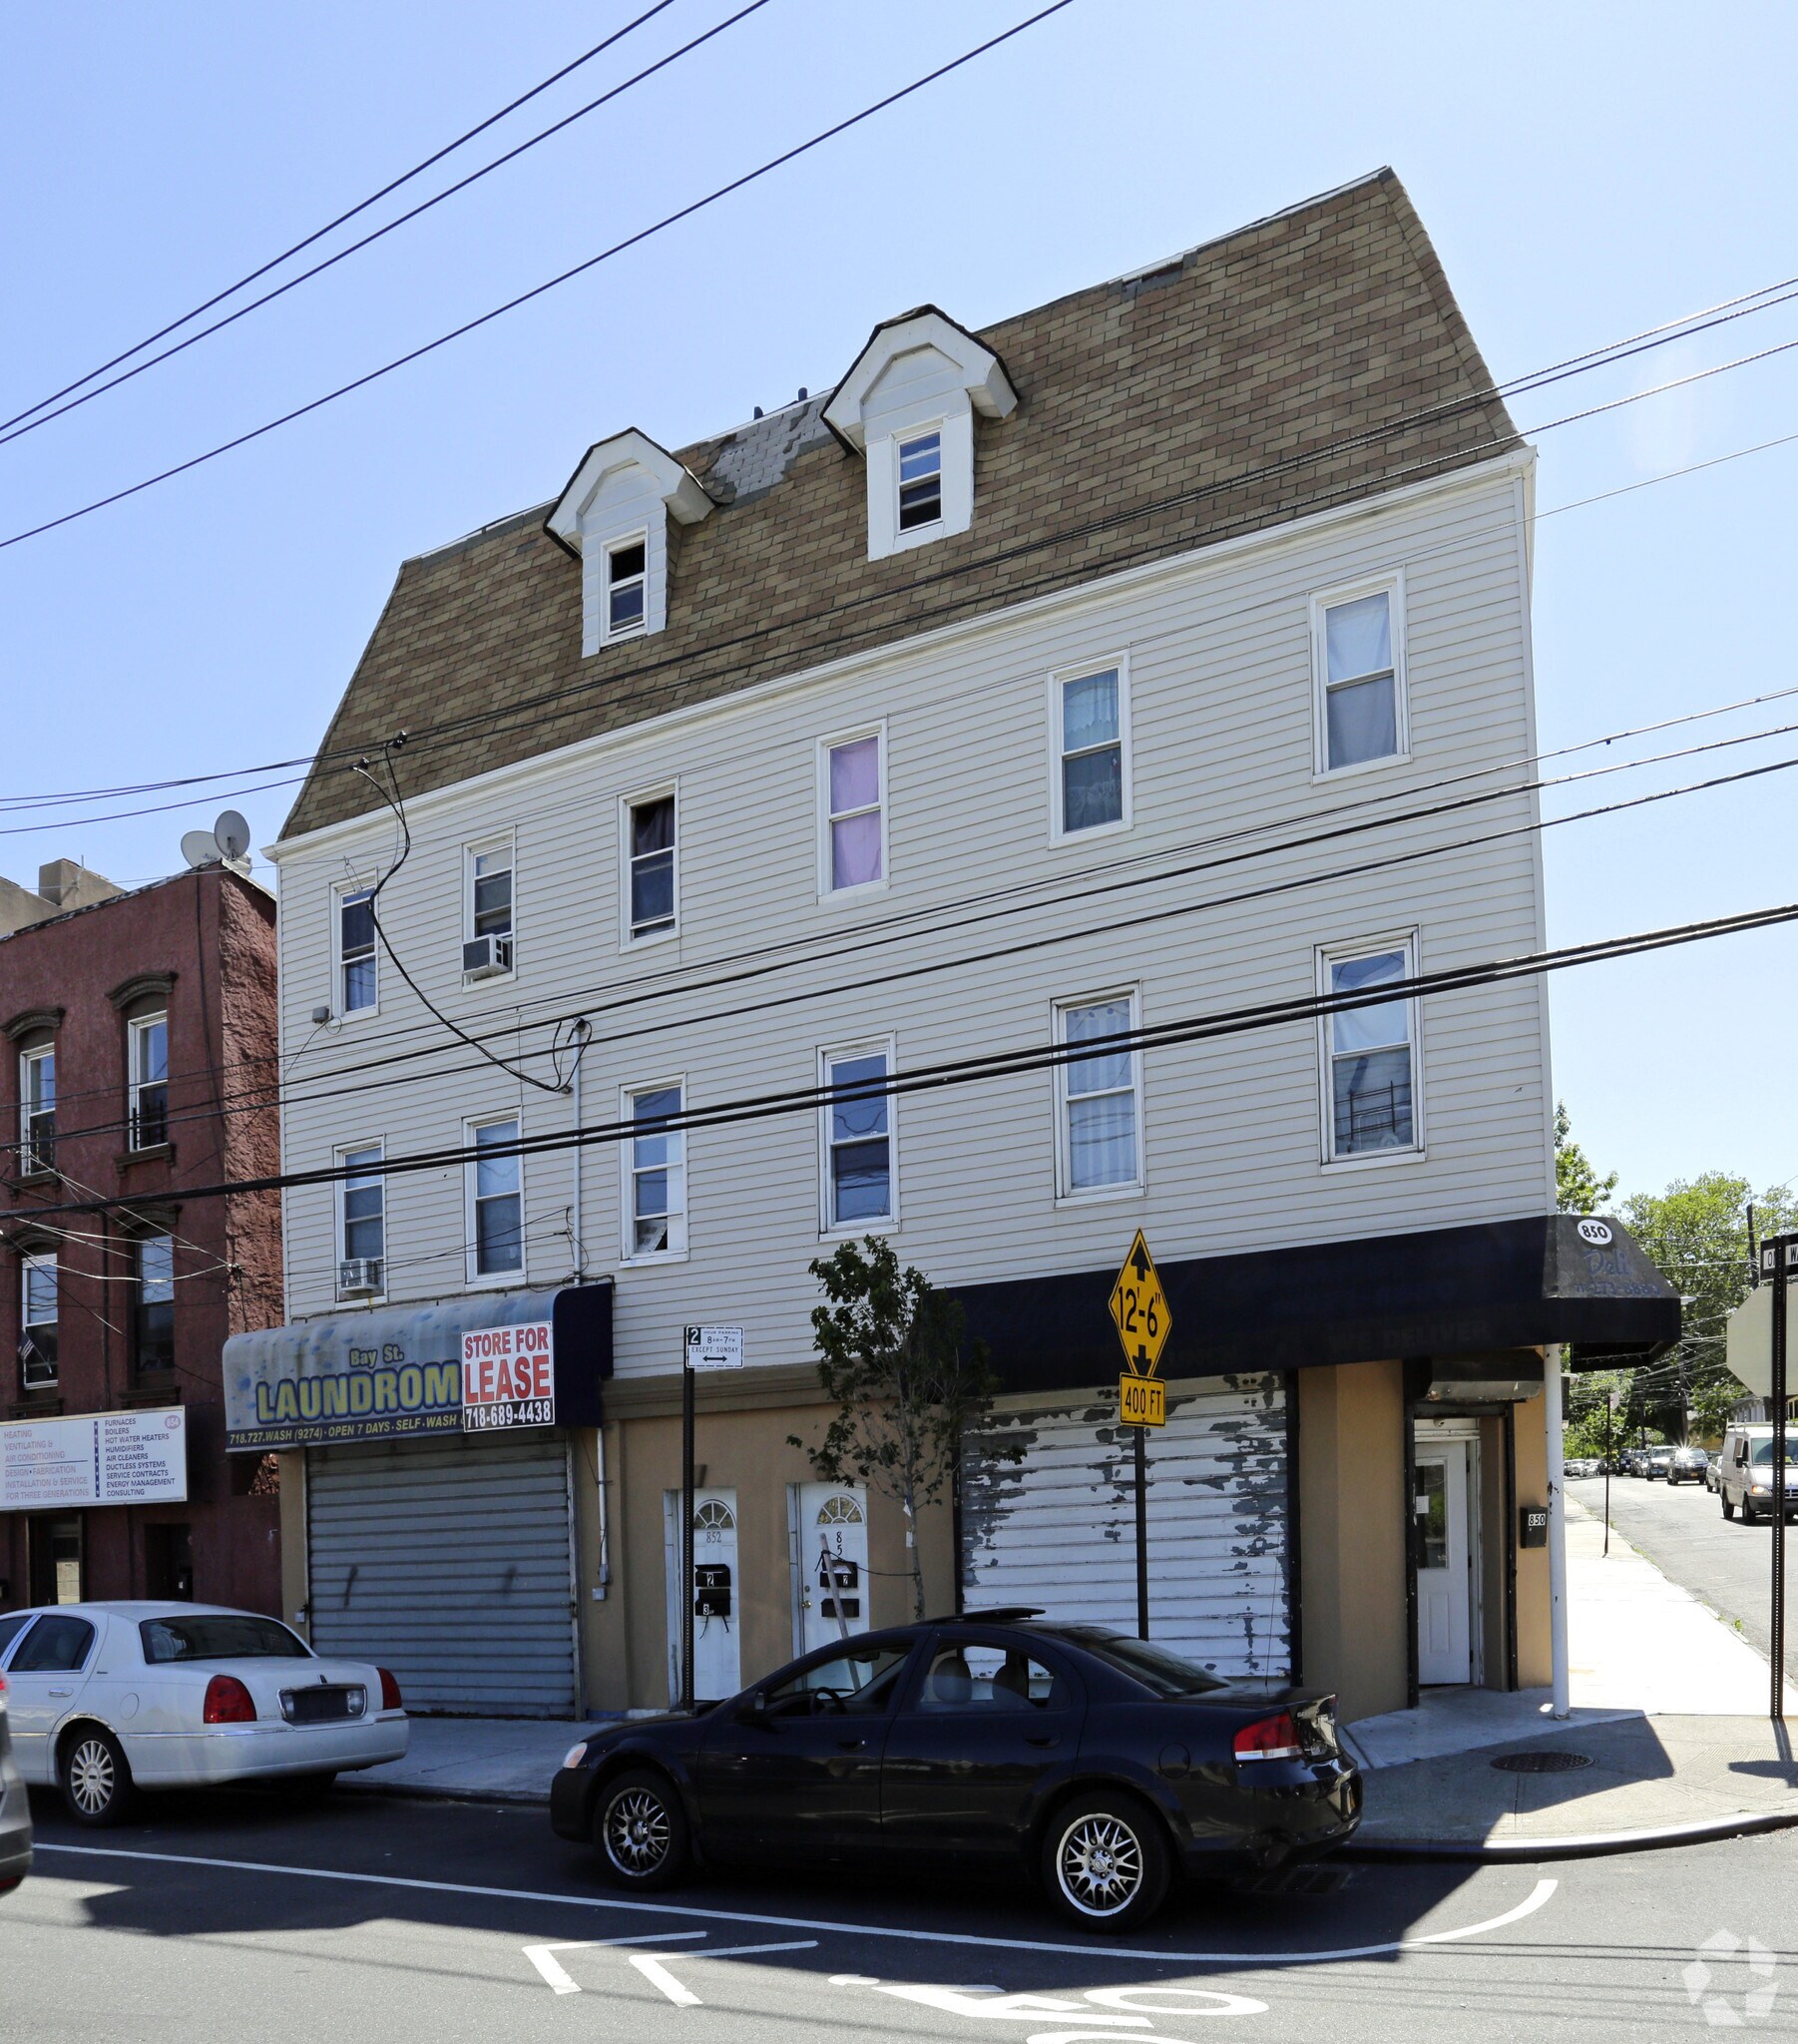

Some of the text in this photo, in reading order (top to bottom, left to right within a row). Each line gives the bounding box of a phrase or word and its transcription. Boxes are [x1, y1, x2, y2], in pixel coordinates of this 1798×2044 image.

[1581, 1226, 1608, 1239] 850
[690, 1328, 698, 1343] 2
[465, 1327, 549, 1359] STORE FOR
[349, 1343, 404, 1368] Bay St.
[465, 1354, 551, 1404] LEASE
[256, 1360, 461, 1424] LAUNDROM
[1125, 1386, 1161, 1415] 400 FT
[465, 1400, 551, 1428] 718-689-4438
[104, 1417, 136, 1427] FURNACES
[4, 1429, 32, 1439] HEATING
[229, 1430, 292, 1445] 718.727.WASH
[294, 1427, 323, 1442] (9274)
[327, 1425, 355, 1437] OPEN
[357, 1423, 365, 1435] 7
[365, 1421, 390, 1433] DAYS
[395, 1417, 421, 1431] SELF
[426, 1414, 457, 1427] WASH
[4, 1439, 54, 1451] VENTILATING &
[106, 1444, 144, 1453] HUMIDIFIERS
[5, 1451, 66, 1463] AIR CONDITIONING
[5, 1465, 76, 1478] DESIGN FABRICATION
[132, 1469, 169, 1478] CONTRACTS
[5, 1478, 52, 1489] INSTALLATION
[60, 1477, 88, 1486] SERVICE
[131, 1478, 176, 1487] MANAGEMENT
[6, 1492, 19, 1501] FOR
[43, 1488, 90, 1499] GENERATIONS
[1529, 1515, 1545, 1525] 850
[706, 1531, 722, 1544] 852
[708, 1574, 714, 1587] 2
[703, 1605, 708, 1615] 3
